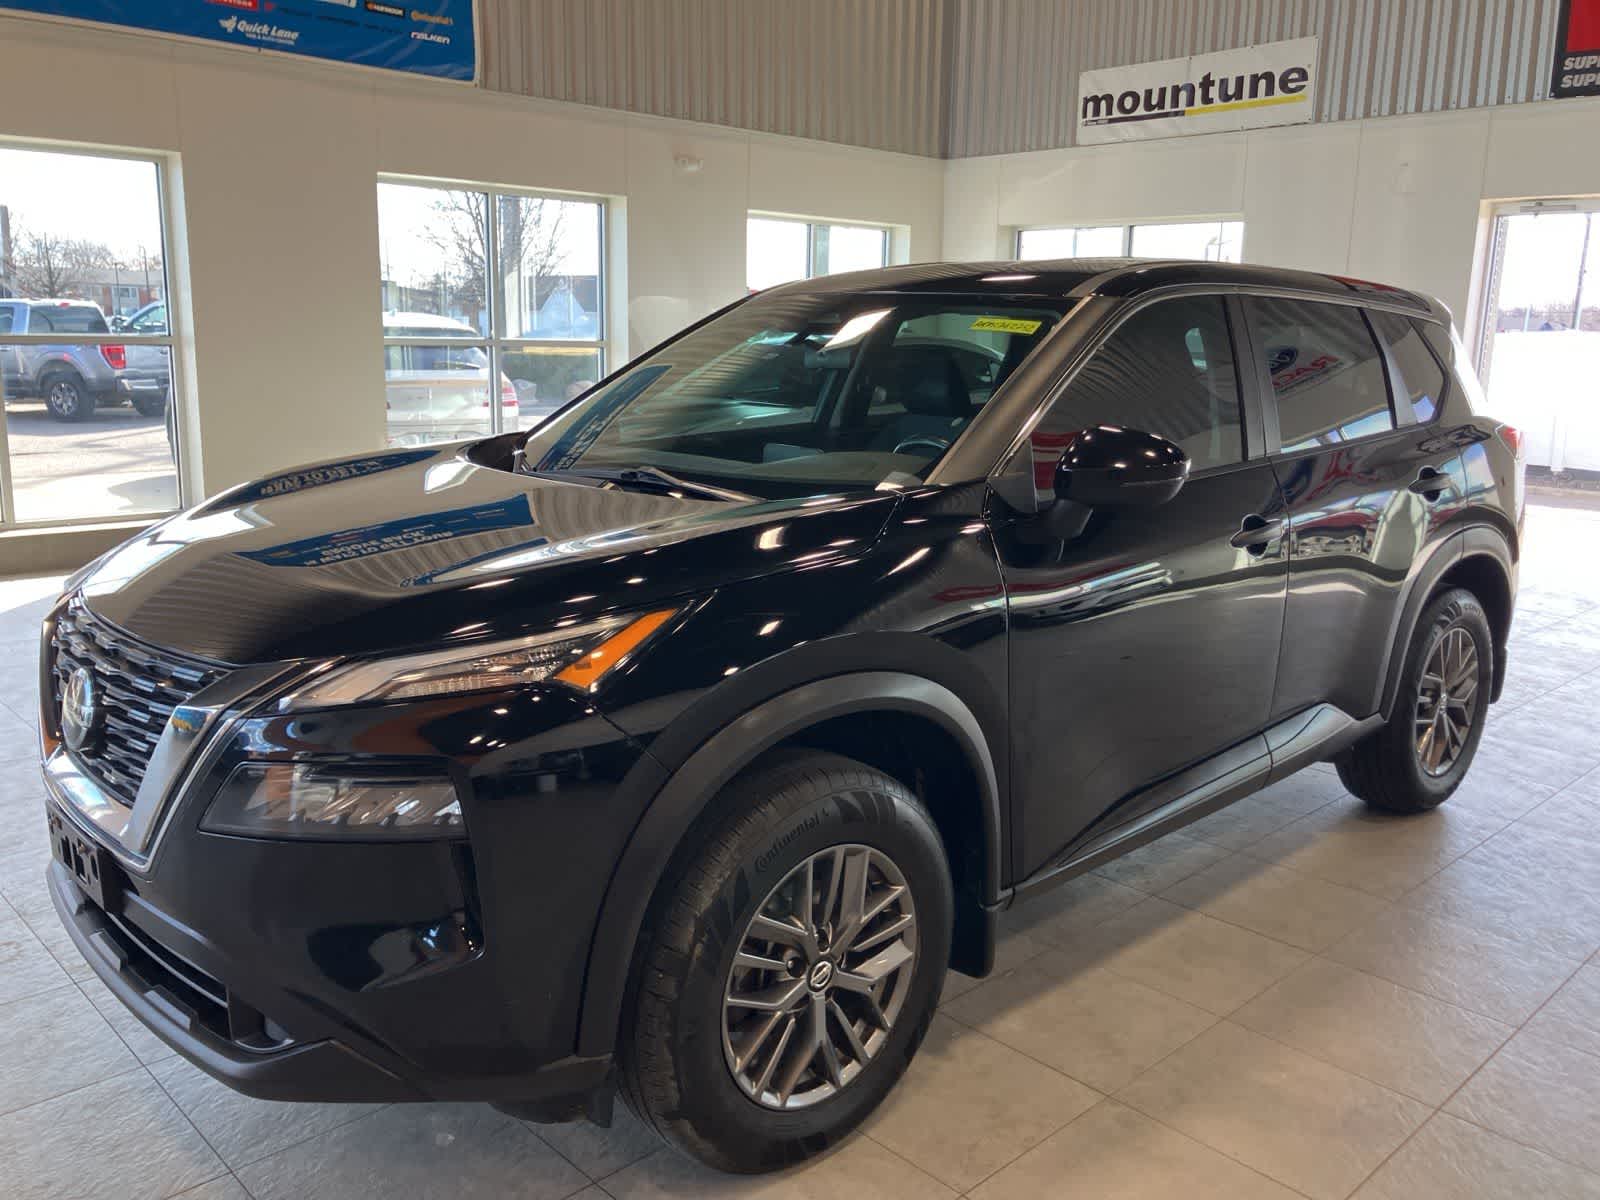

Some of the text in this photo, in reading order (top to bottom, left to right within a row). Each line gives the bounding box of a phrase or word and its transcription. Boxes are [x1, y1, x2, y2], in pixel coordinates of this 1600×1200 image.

[237, 19, 270, 36] Quick
[270, 25, 299, 40] Lane
[1563, 55, 1600, 70] SUP
[1081, 66, 1309, 120] mountune
